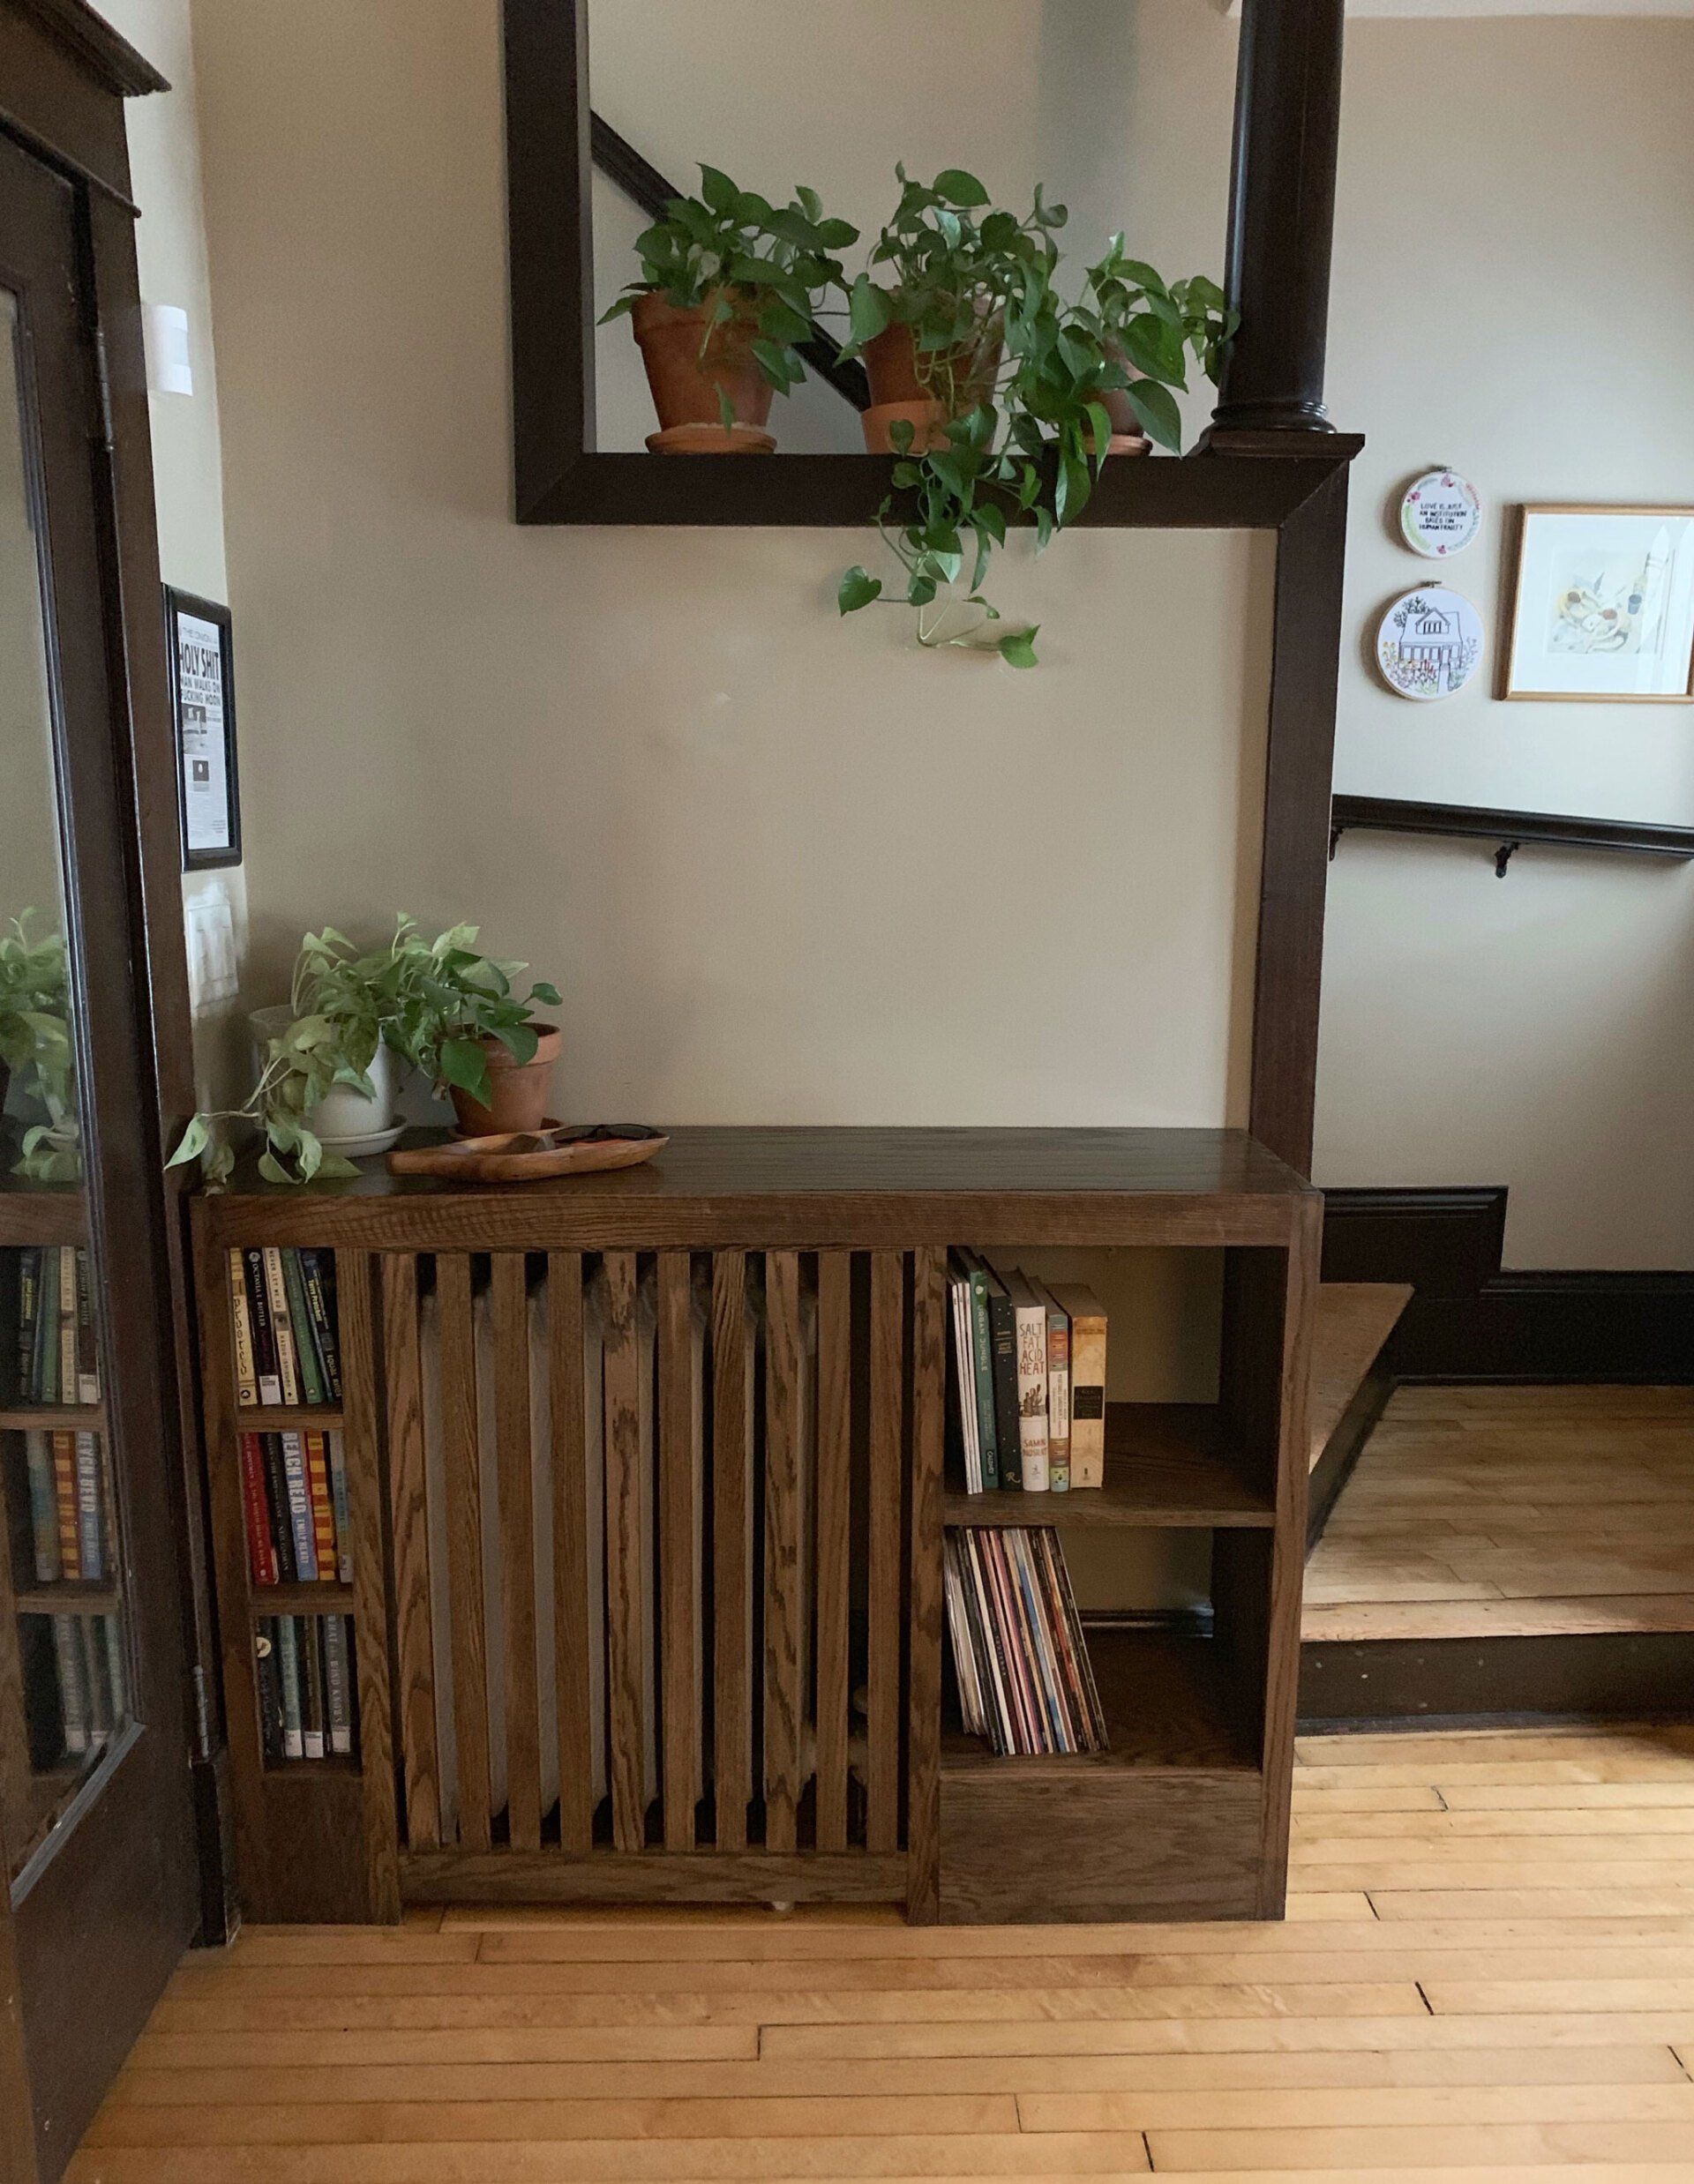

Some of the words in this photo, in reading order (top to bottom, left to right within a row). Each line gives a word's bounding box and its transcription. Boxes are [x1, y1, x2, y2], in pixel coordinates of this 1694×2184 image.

[200, 647, 220, 681] SHIT
[194, 677, 212, 692] WALKS
[182, 689, 205, 704] UCKING
[252, 1262, 261, 1293] OCTAVIA
[257, 1300, 266, 1328] BUTLER
[1019, 1322, 1043, 1337] SALT
[1023, 1335, 1040, 1350] FAT
[1022, 1348, 1044, 1363] ACID
[1019, 1361, 1045, 1376] HEAT
[282, 1432, 302, 1476] BEACH
[289, 1478, 306, 1515] READ
[296, 1518, 306, 1541] EMILY
